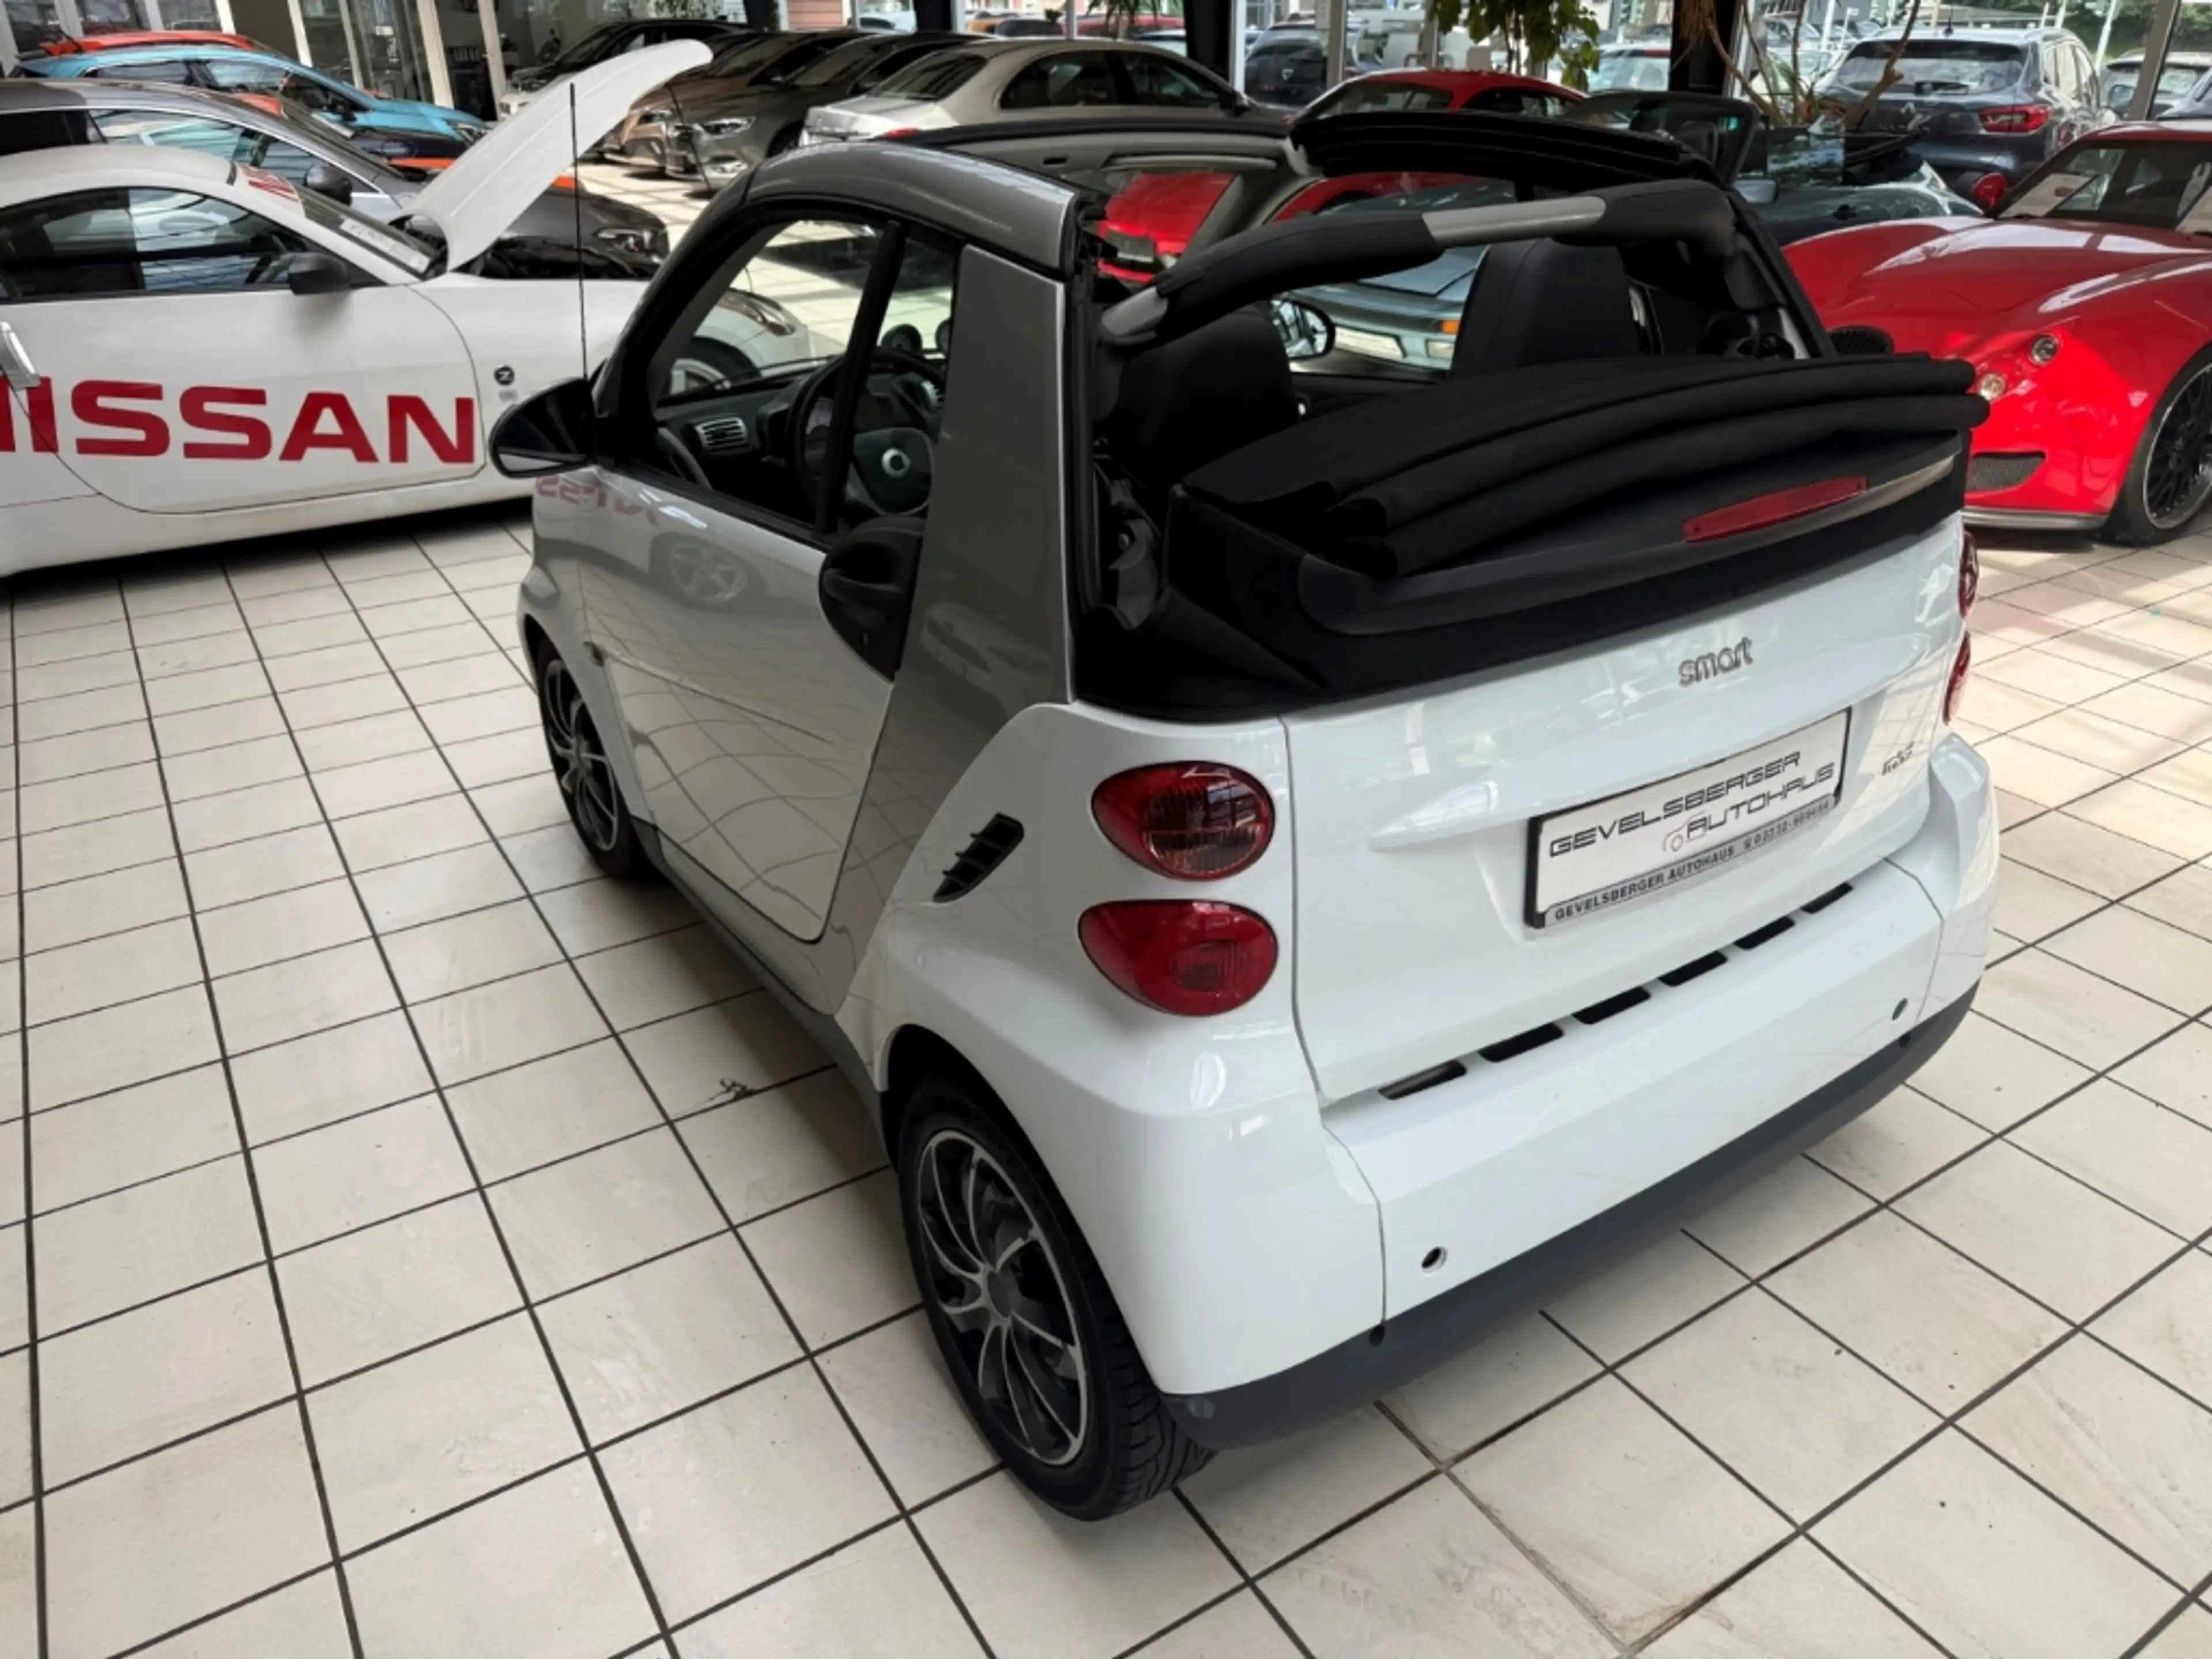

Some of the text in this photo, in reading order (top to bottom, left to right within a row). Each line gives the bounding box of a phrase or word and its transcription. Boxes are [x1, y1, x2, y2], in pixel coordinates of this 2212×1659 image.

[1678, 636, 1753, 687] smart
[1549, 751, 1801, 858] GEVELSBERGER
[1685, 762, 1835, 840] AUTOHAUS
[1555, 873, 1665, 921] GEVELSBERGER
[1667, 844, 1736, 880] AUTOHAUS
